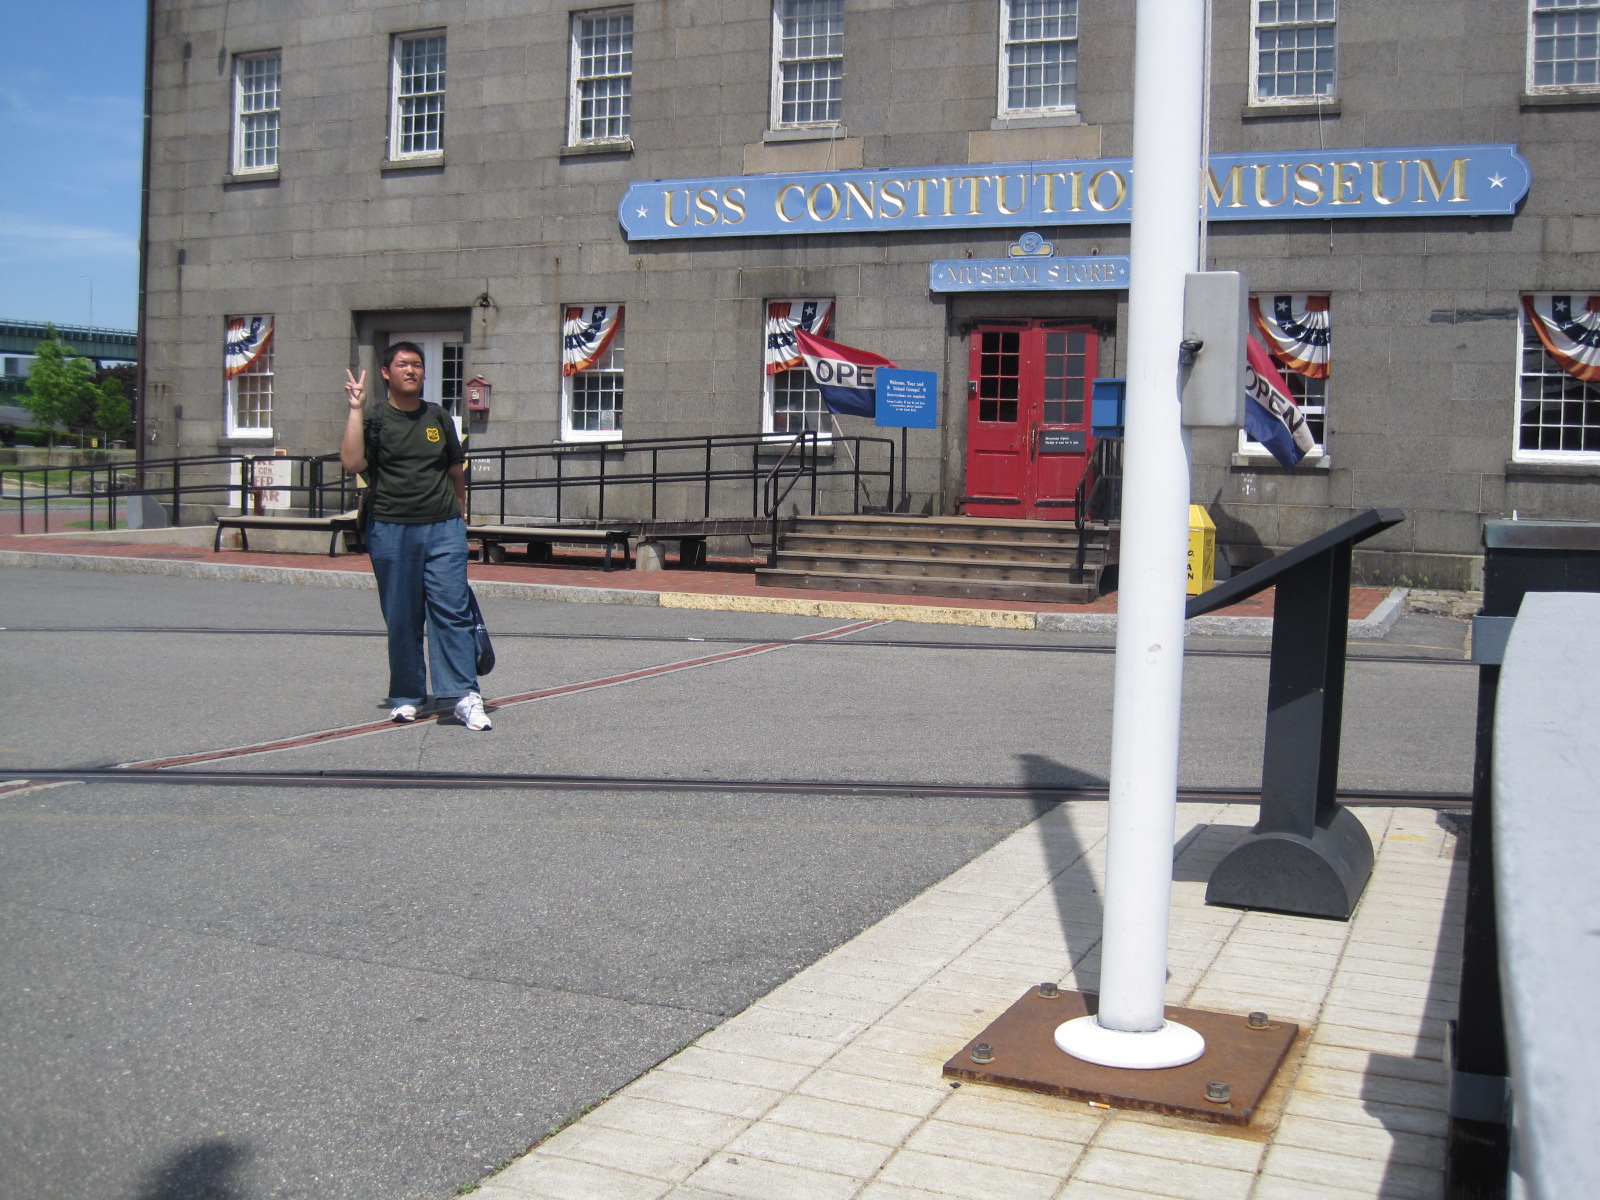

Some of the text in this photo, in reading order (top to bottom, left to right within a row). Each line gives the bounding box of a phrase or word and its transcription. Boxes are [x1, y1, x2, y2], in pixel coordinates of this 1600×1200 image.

[661, 157, 1472, 228] USS CONSTITUTIO MUSEUM
[948, 263, 1116, 284] MUSEUM STORE
[815, 359, 885, 388] OPE
